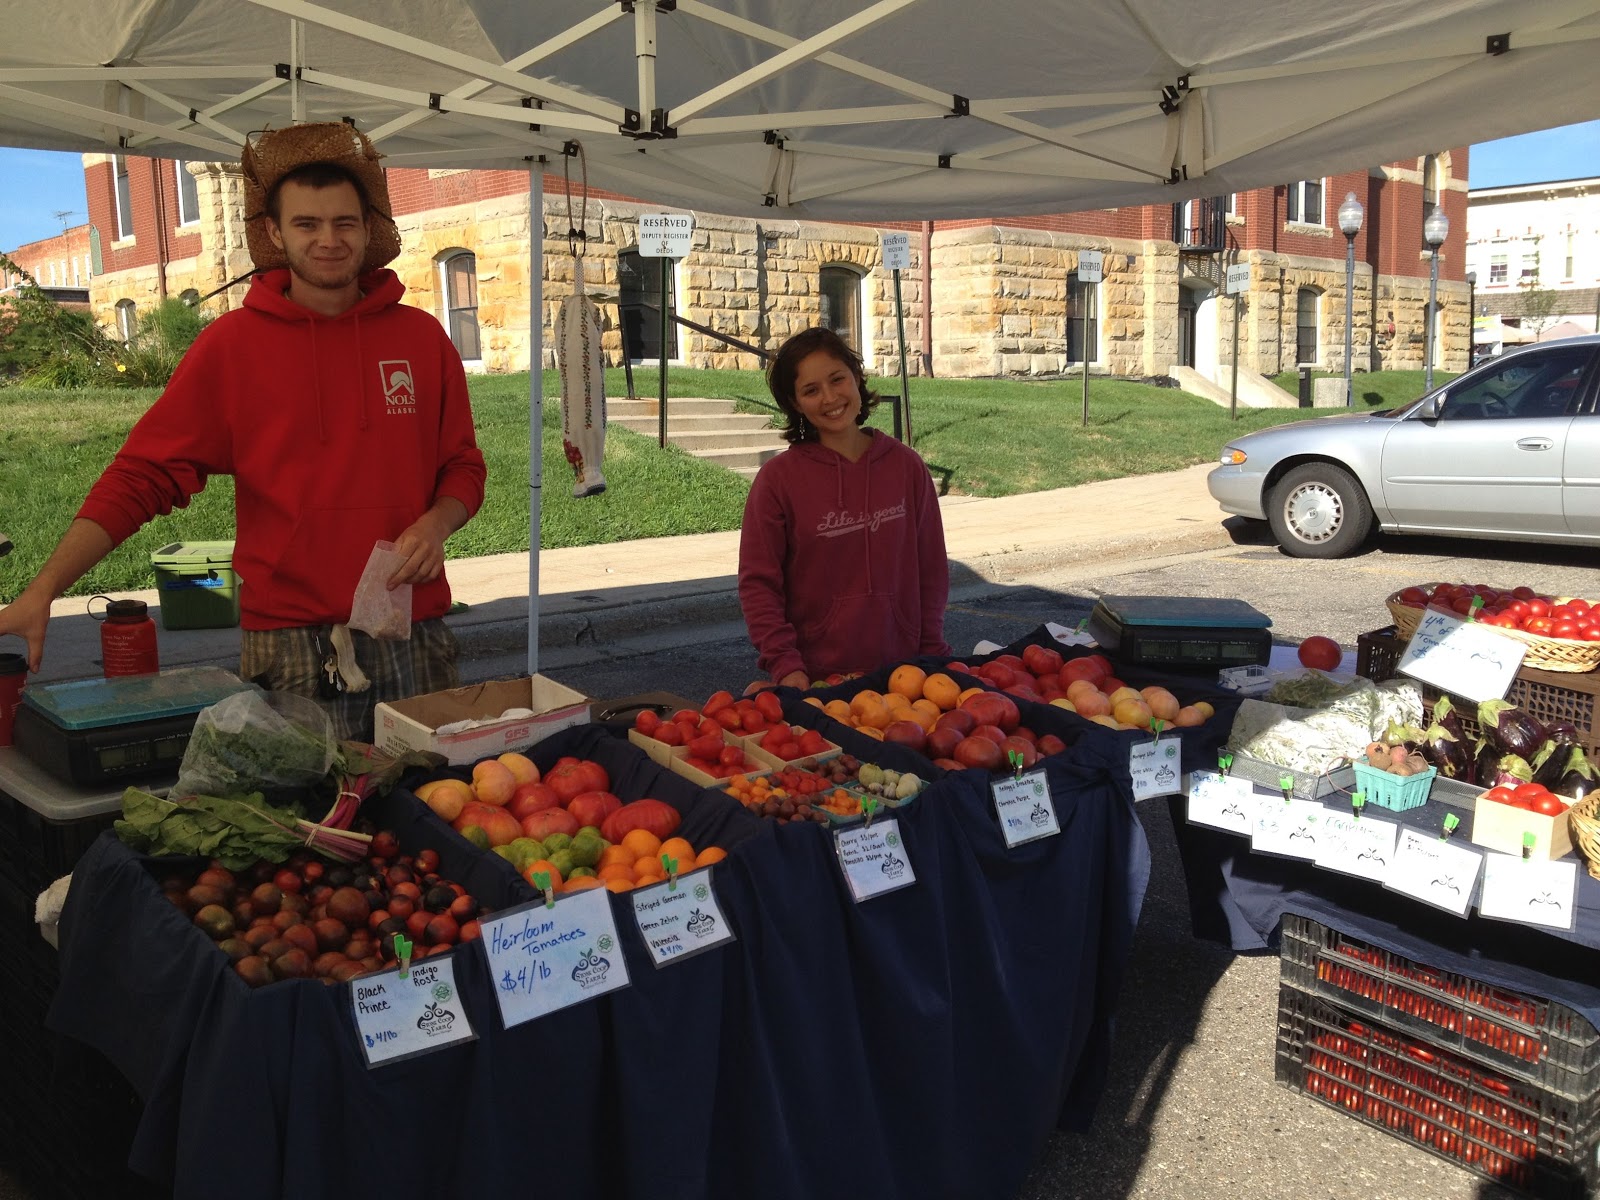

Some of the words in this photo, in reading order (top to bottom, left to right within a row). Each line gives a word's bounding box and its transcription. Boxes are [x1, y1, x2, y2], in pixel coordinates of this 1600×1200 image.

[643, 218, 688, 228] RESERVED
[883, 237, 907, 246] RESERVED
[1080, 261, 1101, 271] RESERVED
[1228, 271, 1249, 283] RESERVED
[385, 394, 416, 406] NOLS
[387, 407, 416, 415] ALASKA
[816, 510, 856, 532] Life
[869, 498, 906, 533] good
[1425, 616, 1446, 629] 4th
[505, 726, 530, 739] GFS
[635, 899, 660, 912] Striped
[662, 892, 687, 904] German
[641, 922, 660, 931] Green
[660, 915, 679, 926] Zebra
[492, 918, 554, 954] Heirloom
[522, 928, 586, 956] Tomatoes
[650, 934, 680, 949] Valencia
[412, 965, 438, 978] Indigo
[500, 959, 551, 995] $4/lb
[413, 975, 439, 986] Rose
[357, 983, 386, 1000] Black
[358, 1000, 391, 1014] Prince
